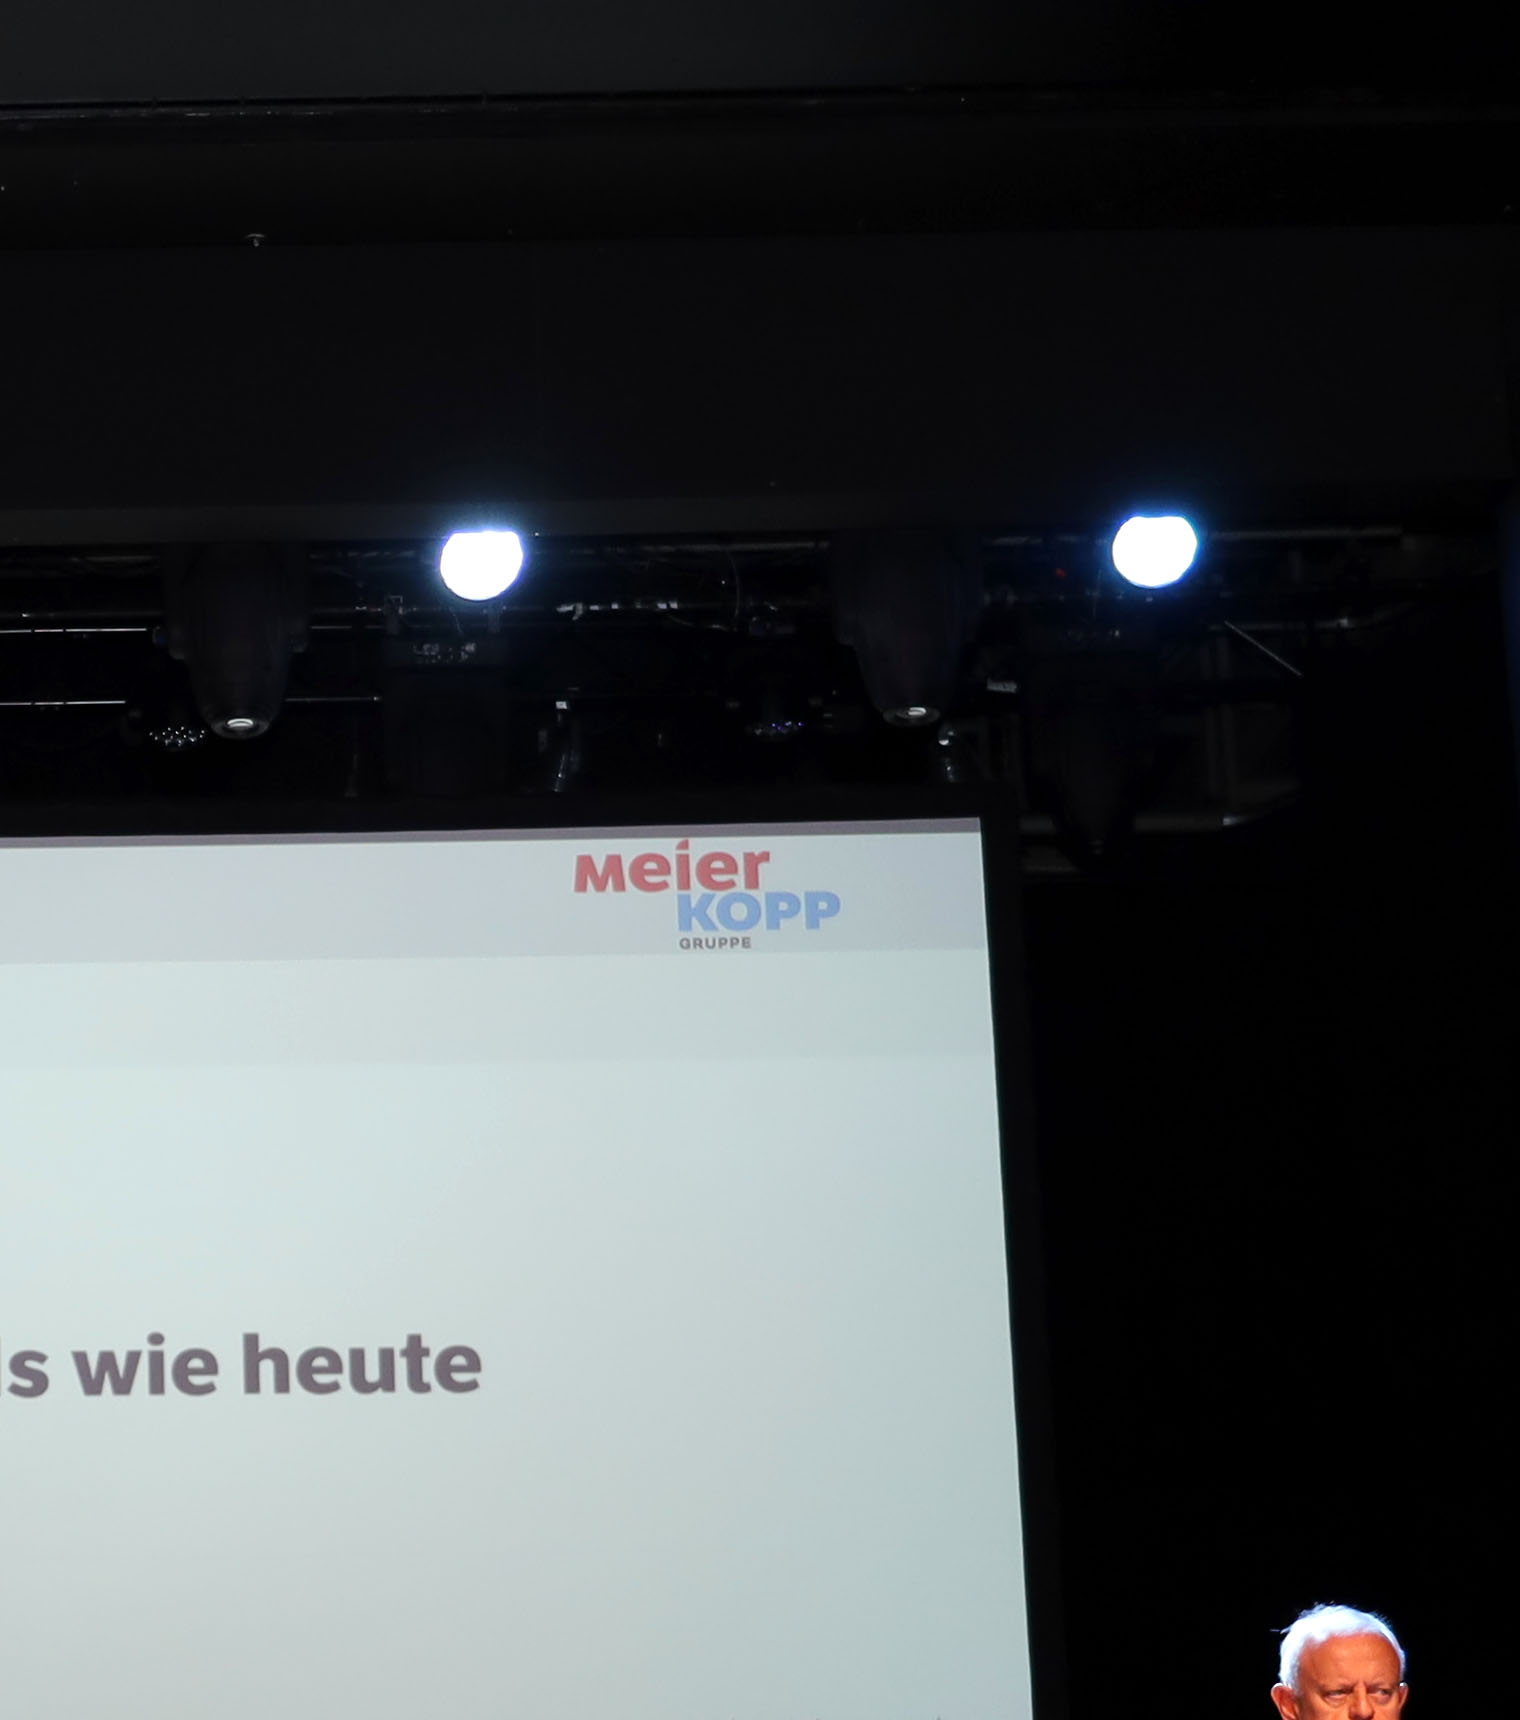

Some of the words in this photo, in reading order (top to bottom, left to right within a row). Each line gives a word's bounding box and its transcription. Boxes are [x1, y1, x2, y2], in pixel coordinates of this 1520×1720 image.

[574, 838, 771, 893] Meier
[677, 890, 842, 932] KOPP
[678, 936, 752, 950] GRUPPE
[70, 1332, 220, 1398] wie
[241, 1332, 484, 1397] heute
